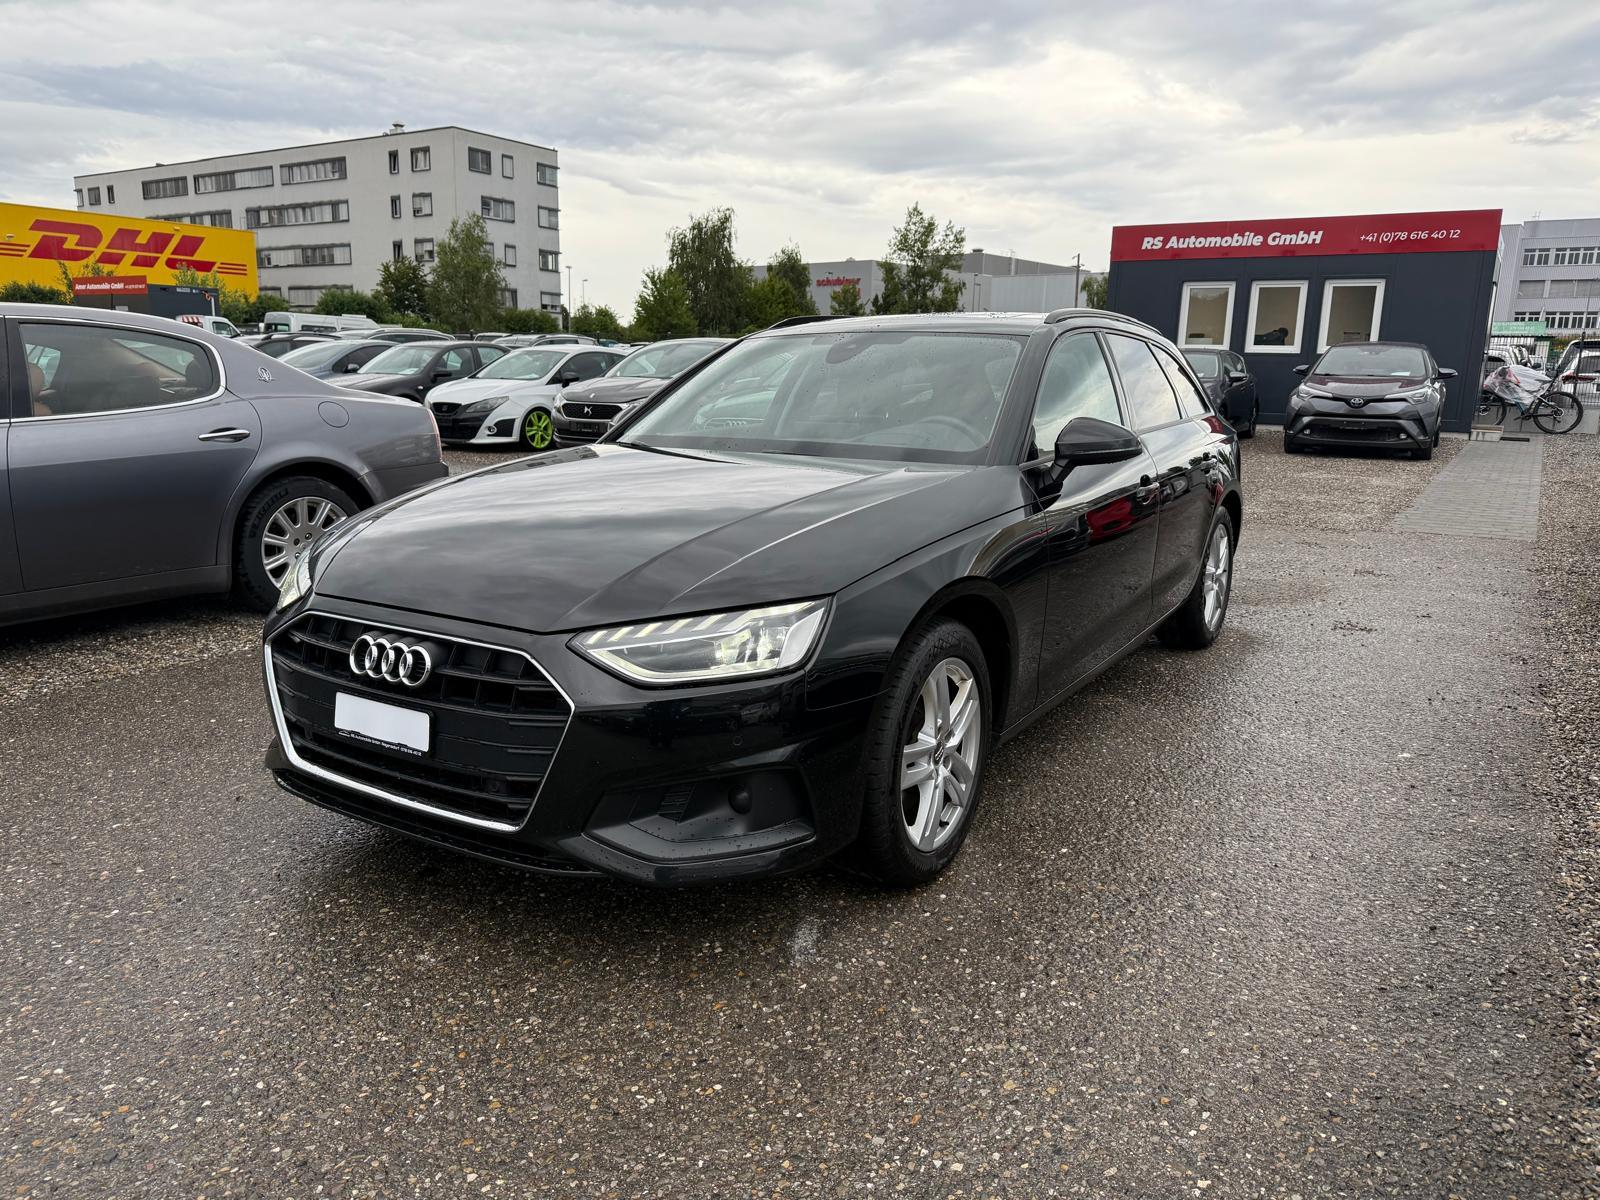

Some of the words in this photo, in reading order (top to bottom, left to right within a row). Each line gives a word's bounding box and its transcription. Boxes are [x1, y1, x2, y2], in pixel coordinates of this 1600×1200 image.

[28, 219, 217, 273] DHL
[1141, 236, 1164, 250] RS
[1165, 232, 1263, 249] Automobile
[1267, 230, 1324, 246] GmbH
[1360, 232, 1378, 243] +41
[1379, 231, 1408, 244] (0)78
[1409, 230, 1429, 240] 616
[1431, 230, 1447, 239] 40
[1449, 229, 1461, 239] 12
